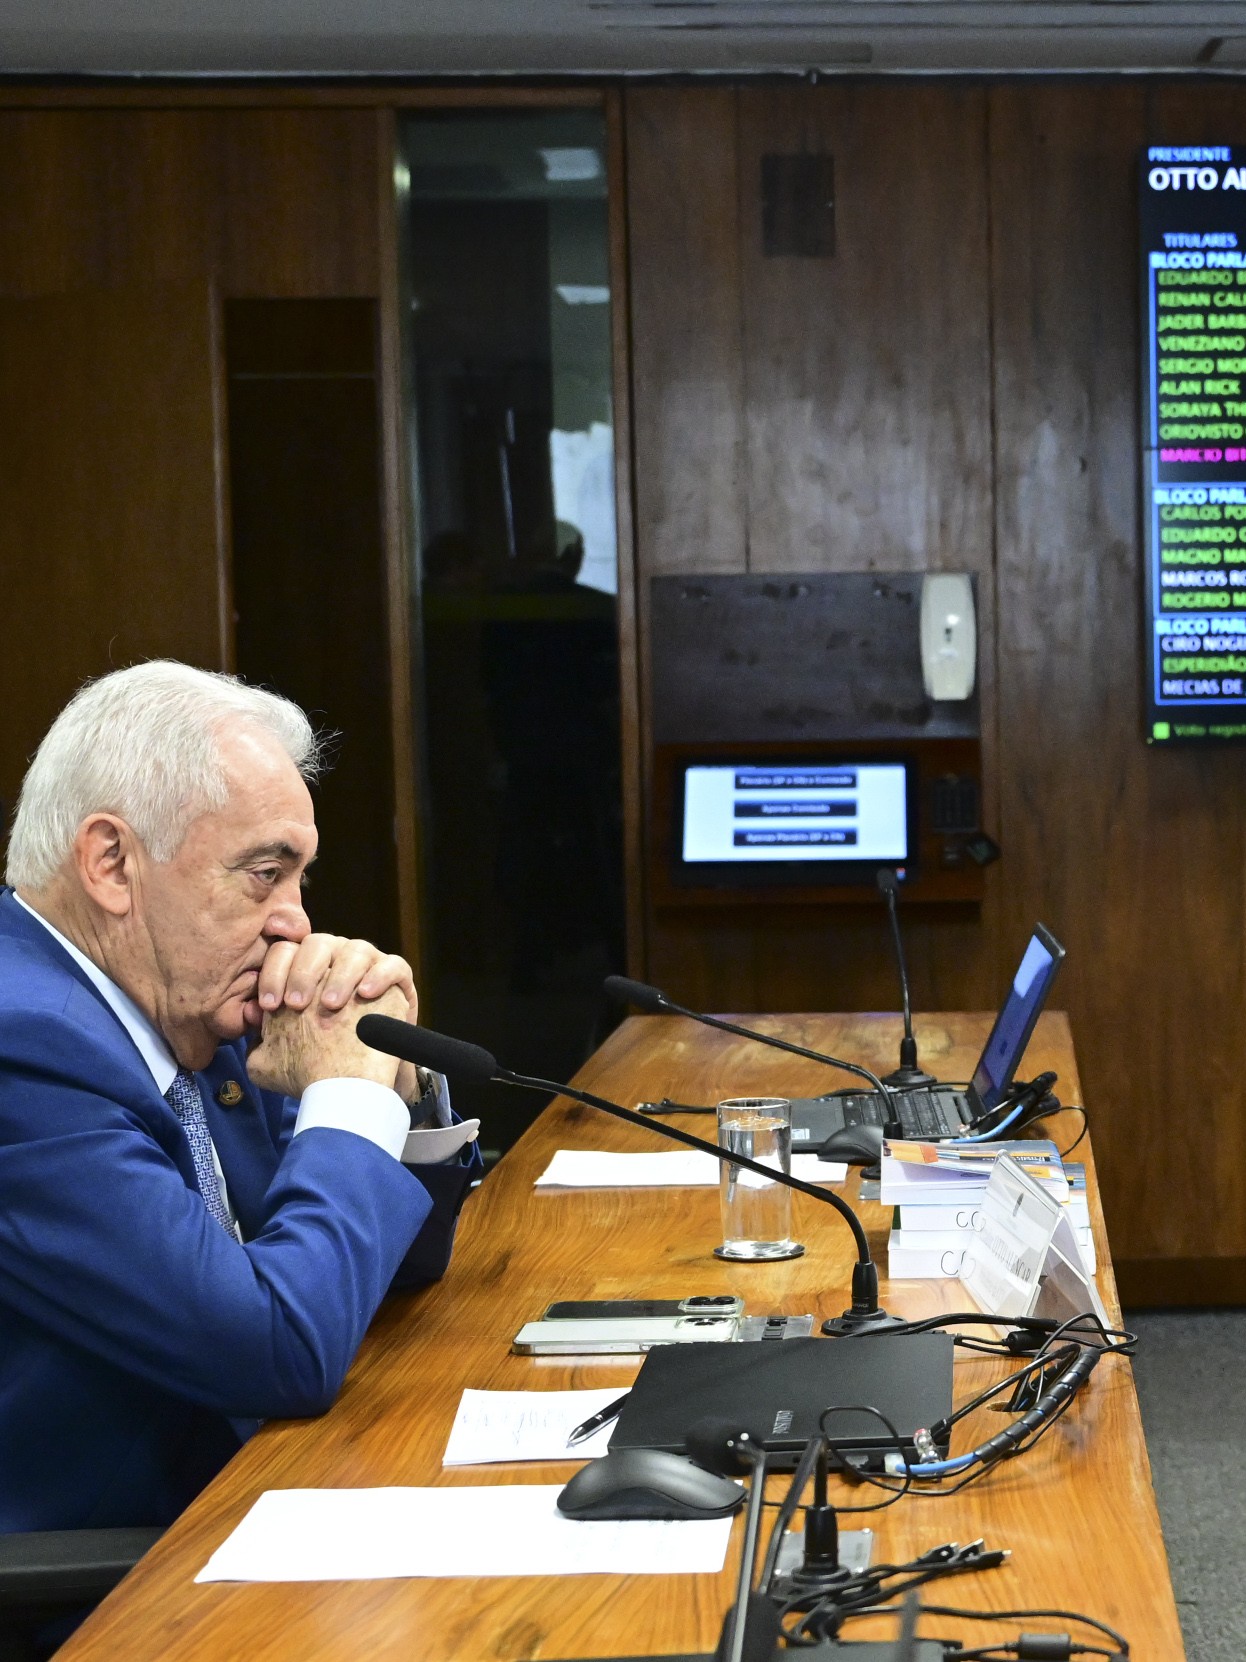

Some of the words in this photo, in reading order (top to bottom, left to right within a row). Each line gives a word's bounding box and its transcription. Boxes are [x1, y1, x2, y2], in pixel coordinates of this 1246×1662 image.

[1149, 167, 1218, 190] OTTO
[1163, 233, 1237, 248] TITULARES
[1149, 253, 1205, 268] BLOCO
[1159, 381, 1201, 395] ALAN
[1154, 489, 1207, 504] BLOCO
[1161, 571, 1227, 586] MARCOS
[1155, 619, 1208, 635] BLOCO
[1222, 679, 1243, 694] DE
